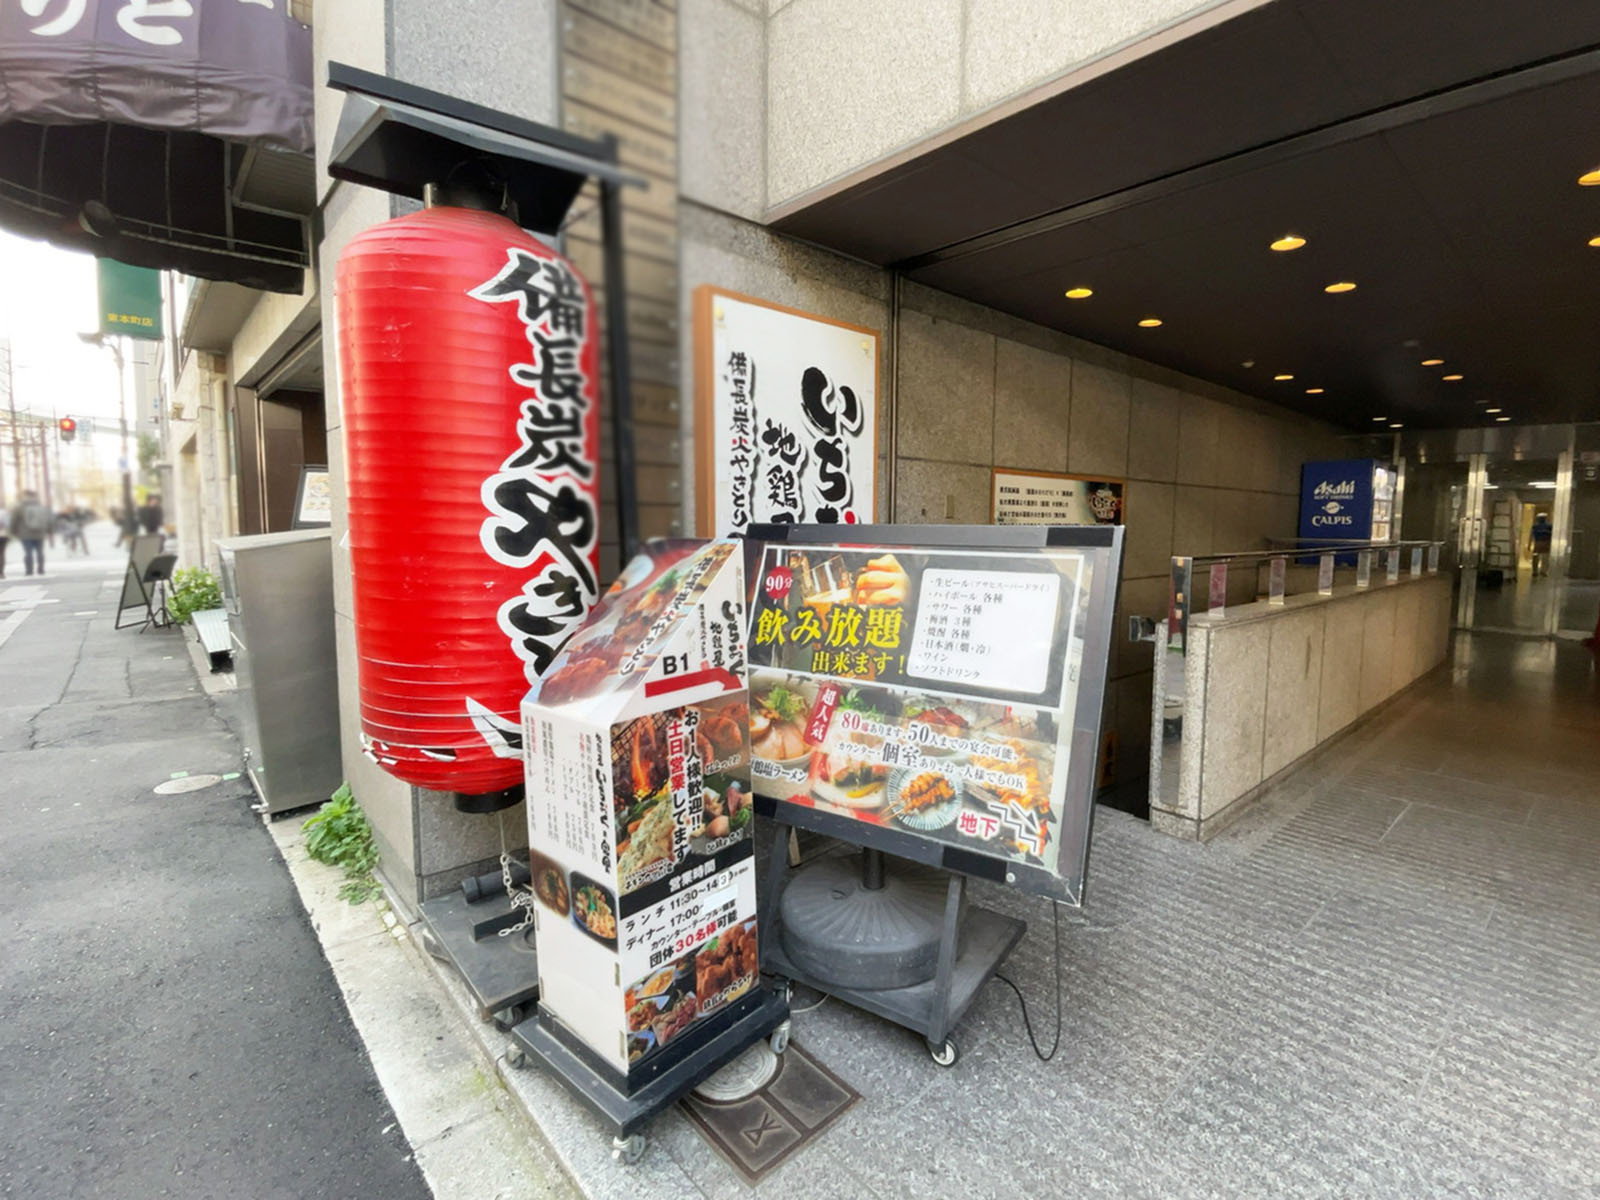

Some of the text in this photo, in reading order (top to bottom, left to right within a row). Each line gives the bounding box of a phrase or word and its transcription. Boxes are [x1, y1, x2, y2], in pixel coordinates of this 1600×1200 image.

[1314, 480, 1355, 494] Asahi
[1311, 515, 1352, 527] CALPIS
[755, 607, 904, 649] 飲み放題
[663, 653, 689, 675] B1
[811, 651, 904, 675] 出来ます!
[809, 688, 839, 741] 超人気
[668, 721, 690, 862] 土日営業してます
[960, 811, 998, 837] 地下
[669, 859, 716, 892] 営業時間
[625, 906, 666, 933] ランチ
[626, 902, 704, 951] ディナー 17:00
[649, 909, 738, 969] 団体30名様可能
